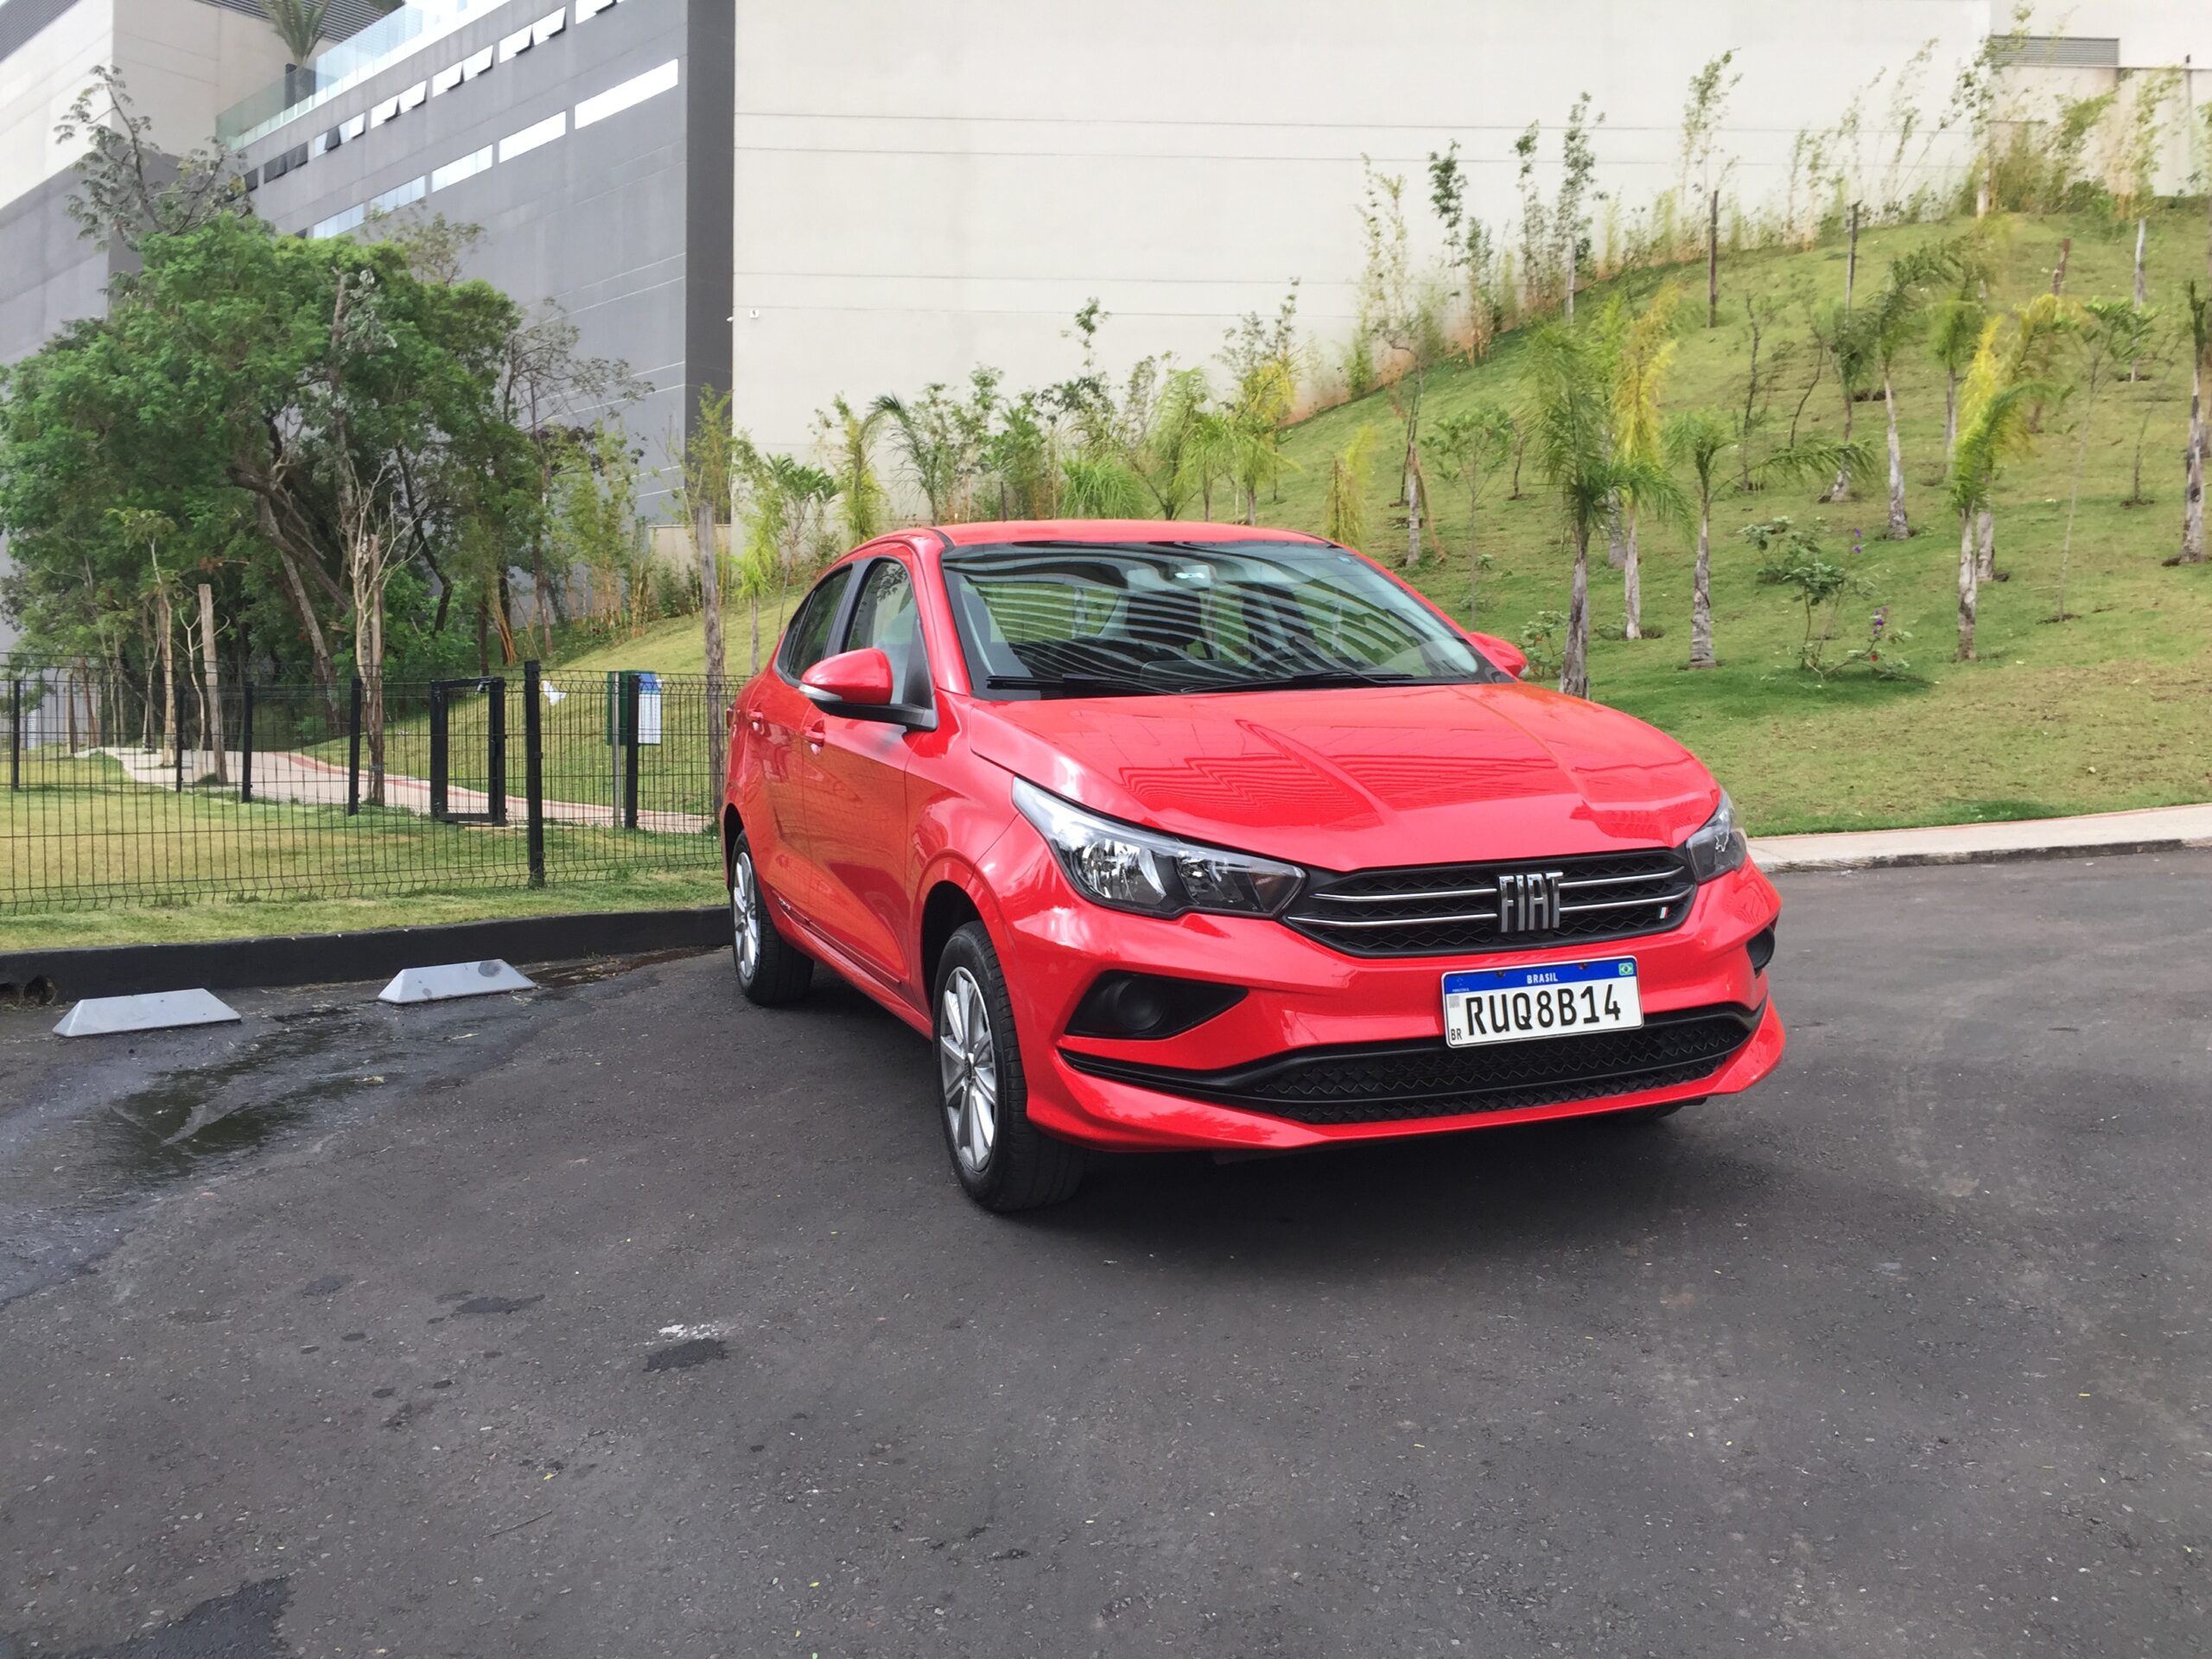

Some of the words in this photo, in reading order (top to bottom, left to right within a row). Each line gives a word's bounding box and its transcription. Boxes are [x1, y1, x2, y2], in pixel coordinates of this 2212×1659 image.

[1499, 871, 1563, 932] FIAT
[1527, 972, 1558, 984] BRASIL
[1465, 983, 1621, 1036] RUQ8B14
[1451, 1028, 1462, 1040] BR
